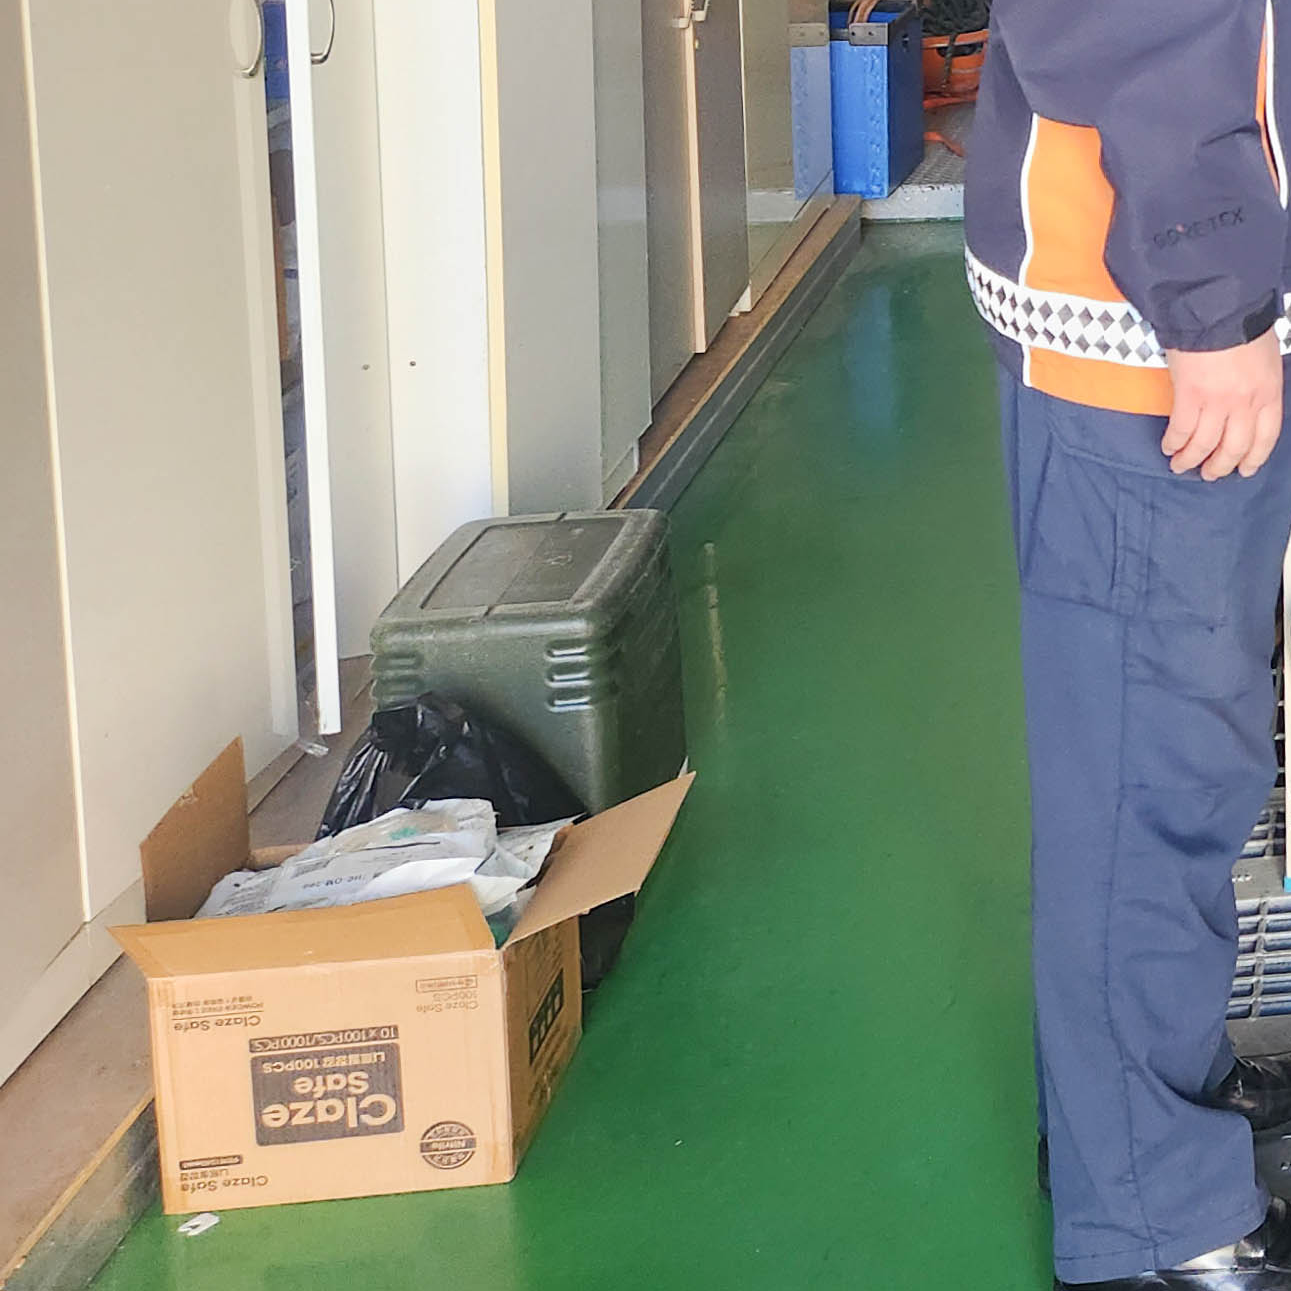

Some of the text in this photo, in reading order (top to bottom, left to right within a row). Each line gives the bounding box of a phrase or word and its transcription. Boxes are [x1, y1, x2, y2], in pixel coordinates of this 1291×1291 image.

[173, 1015, 262, 1033] Claze Safe
[262, 1059, 320, 1074] 100PCS
[293, 1071, 370, 1099] Safe
[261, 1093, 397, 1128] Claze
[180, 1175, 269, 1194] Claze Safe
